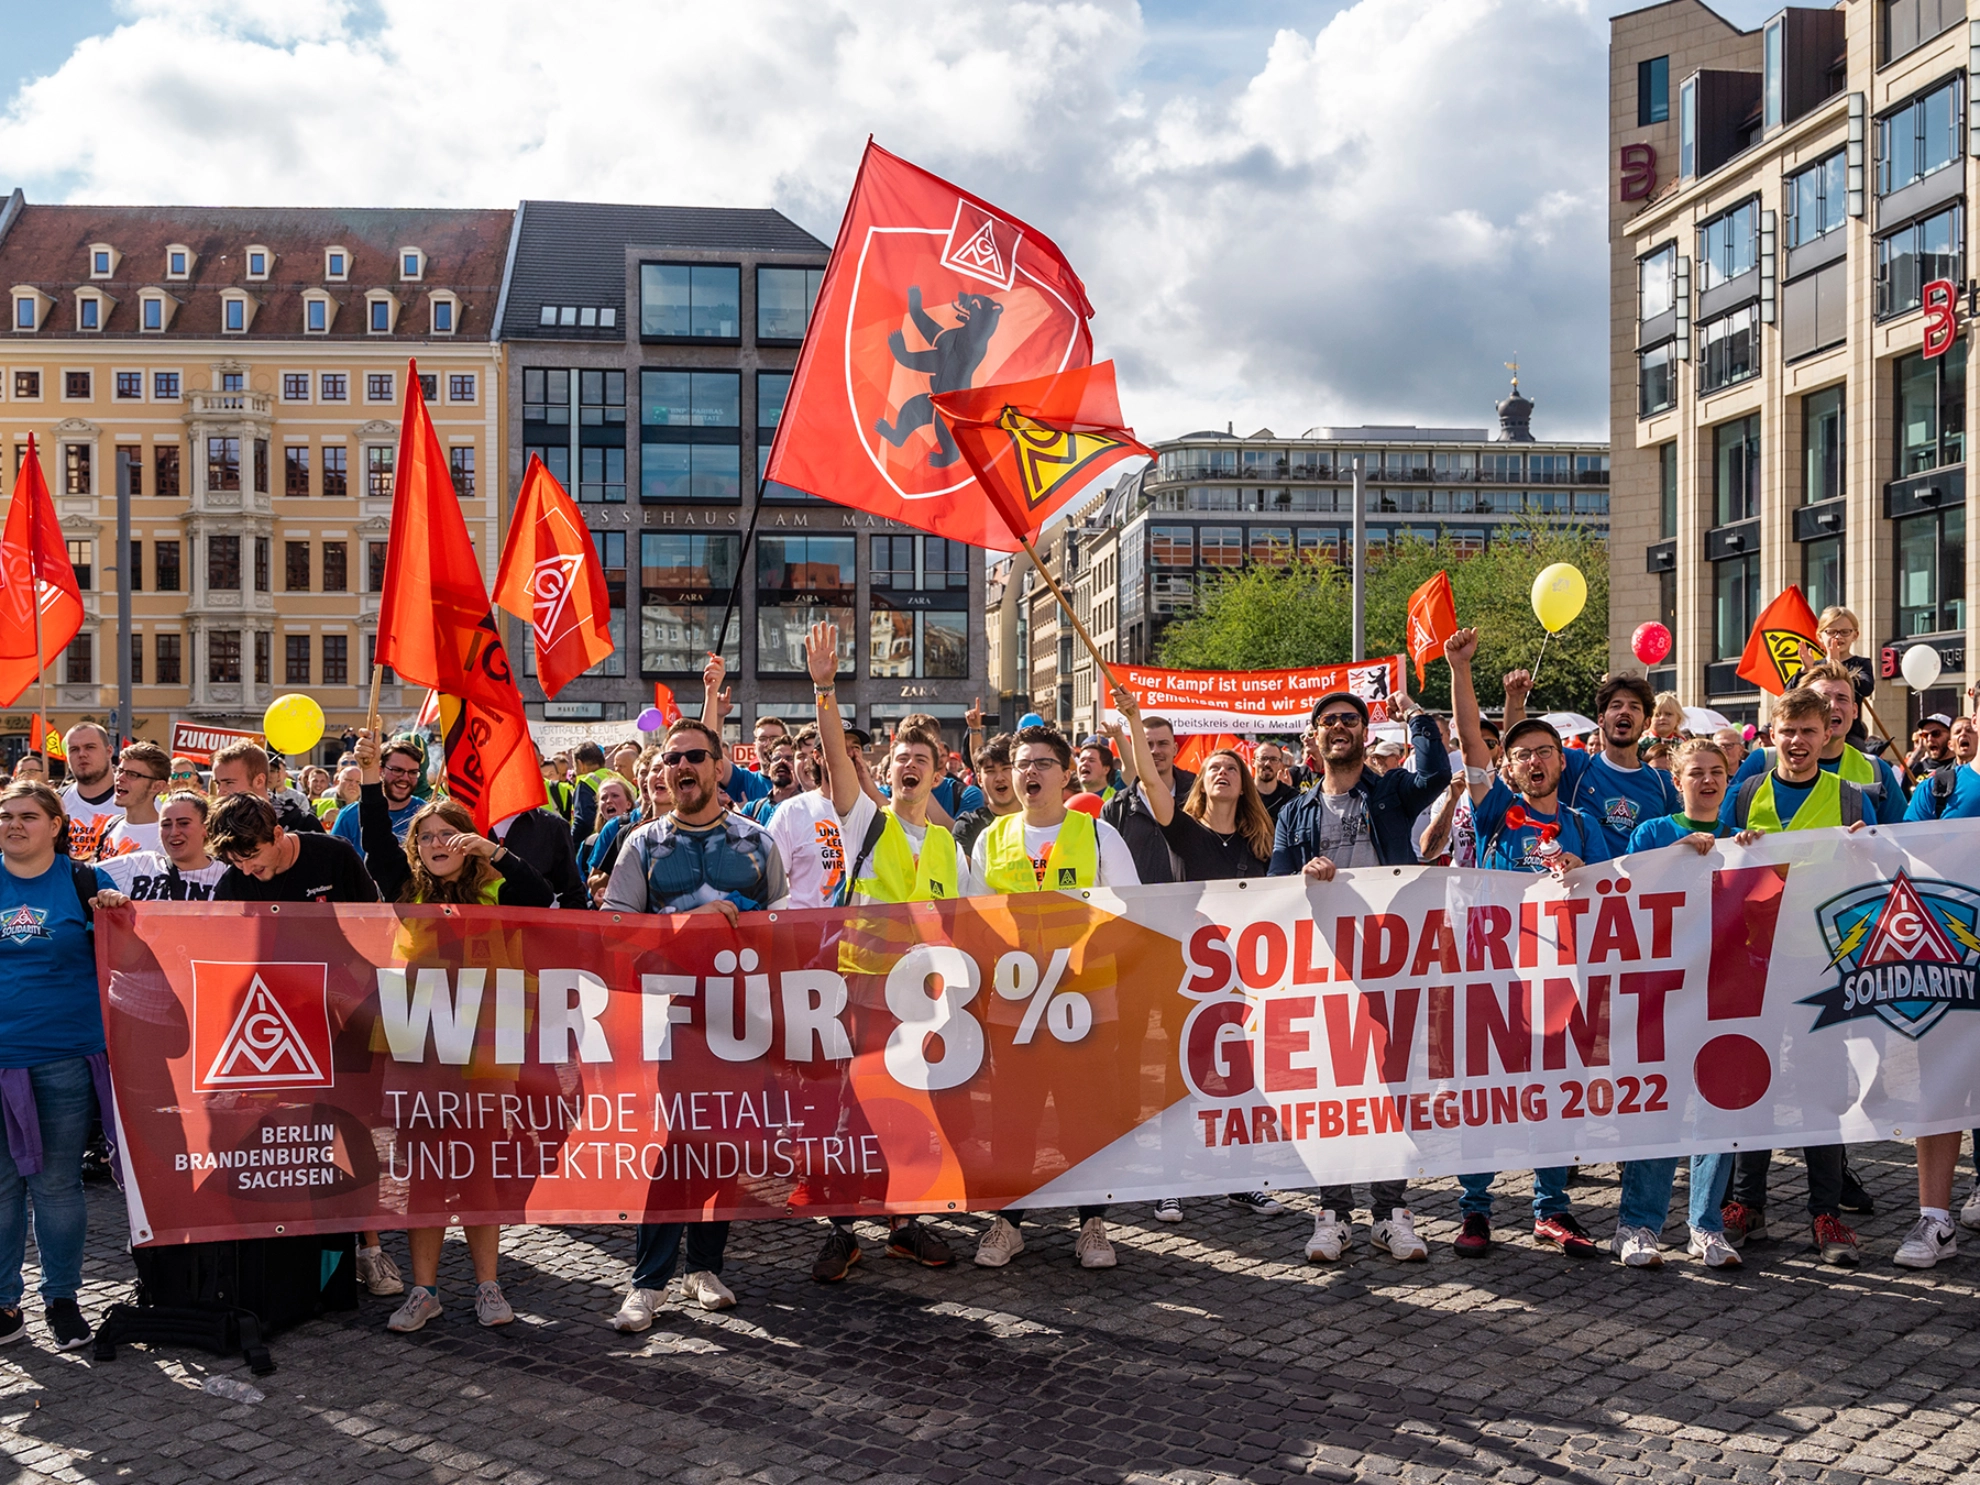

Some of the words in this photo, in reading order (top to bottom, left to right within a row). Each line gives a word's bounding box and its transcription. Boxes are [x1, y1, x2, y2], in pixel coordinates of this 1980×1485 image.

[580, 509, 736, 526] ESSEHAUS
[774, 513, 808, 527] AM
[842, 514, 911, 528] MAR
[678, 593, 704, 602] ZARA
[794, 594, 820, 603] ZARA
[907, 596, 932, 605] ZARA
[900, 685, 938, 698] ZARA
[1130, 672, 1162, 689] Euer
[1166, 674, 1215, 694] Kampf
[1219, 677, 1237, 692] ist
[1242, 678, 1283, 692] unser
[1288, 671, 1336, 691] Kampf
[1147, 690, 1229, 709] gemeinsam
[1234, 697, 1266, 711] sind
[1271, 696, 1295, 711] wir
[1231, 718, 1250, 728] der
[1253, 719, 1265, 729] IG
[1268, 719, 1301, 729] Metall
[177, 729, 250, 751] ZUKUNF
[819, 828, 840, 837] UNS
[1, 924, 42, 938] SOLIDARITY
[1187, 877, 1686, 994] SOLIDARITÄT
[1842, 964, 1976, 1012] SOLIDARITY
[376, 967, 614, 1065] WIR
[641, 947, 855, 1063] FÜR
[385, 1090, 639, 1133] TARIFRUNDE
[653, 1090, 815, 1133] METALL-
[1197, 1083, 1548, 1148] TARIFBEWEGUNG
[1558, 1073, 1669, 1119] 2022
[261, 1124, 334, 1144] BERLIN
[174, 1146, 335, 1172] BRANDENBURG
[388, 1140, 475, 1182] UND
[491, 1134, 883, 1182] ELEKTROINDUSTRIE
[237, 1167, 334, 1190] SACHSEN
